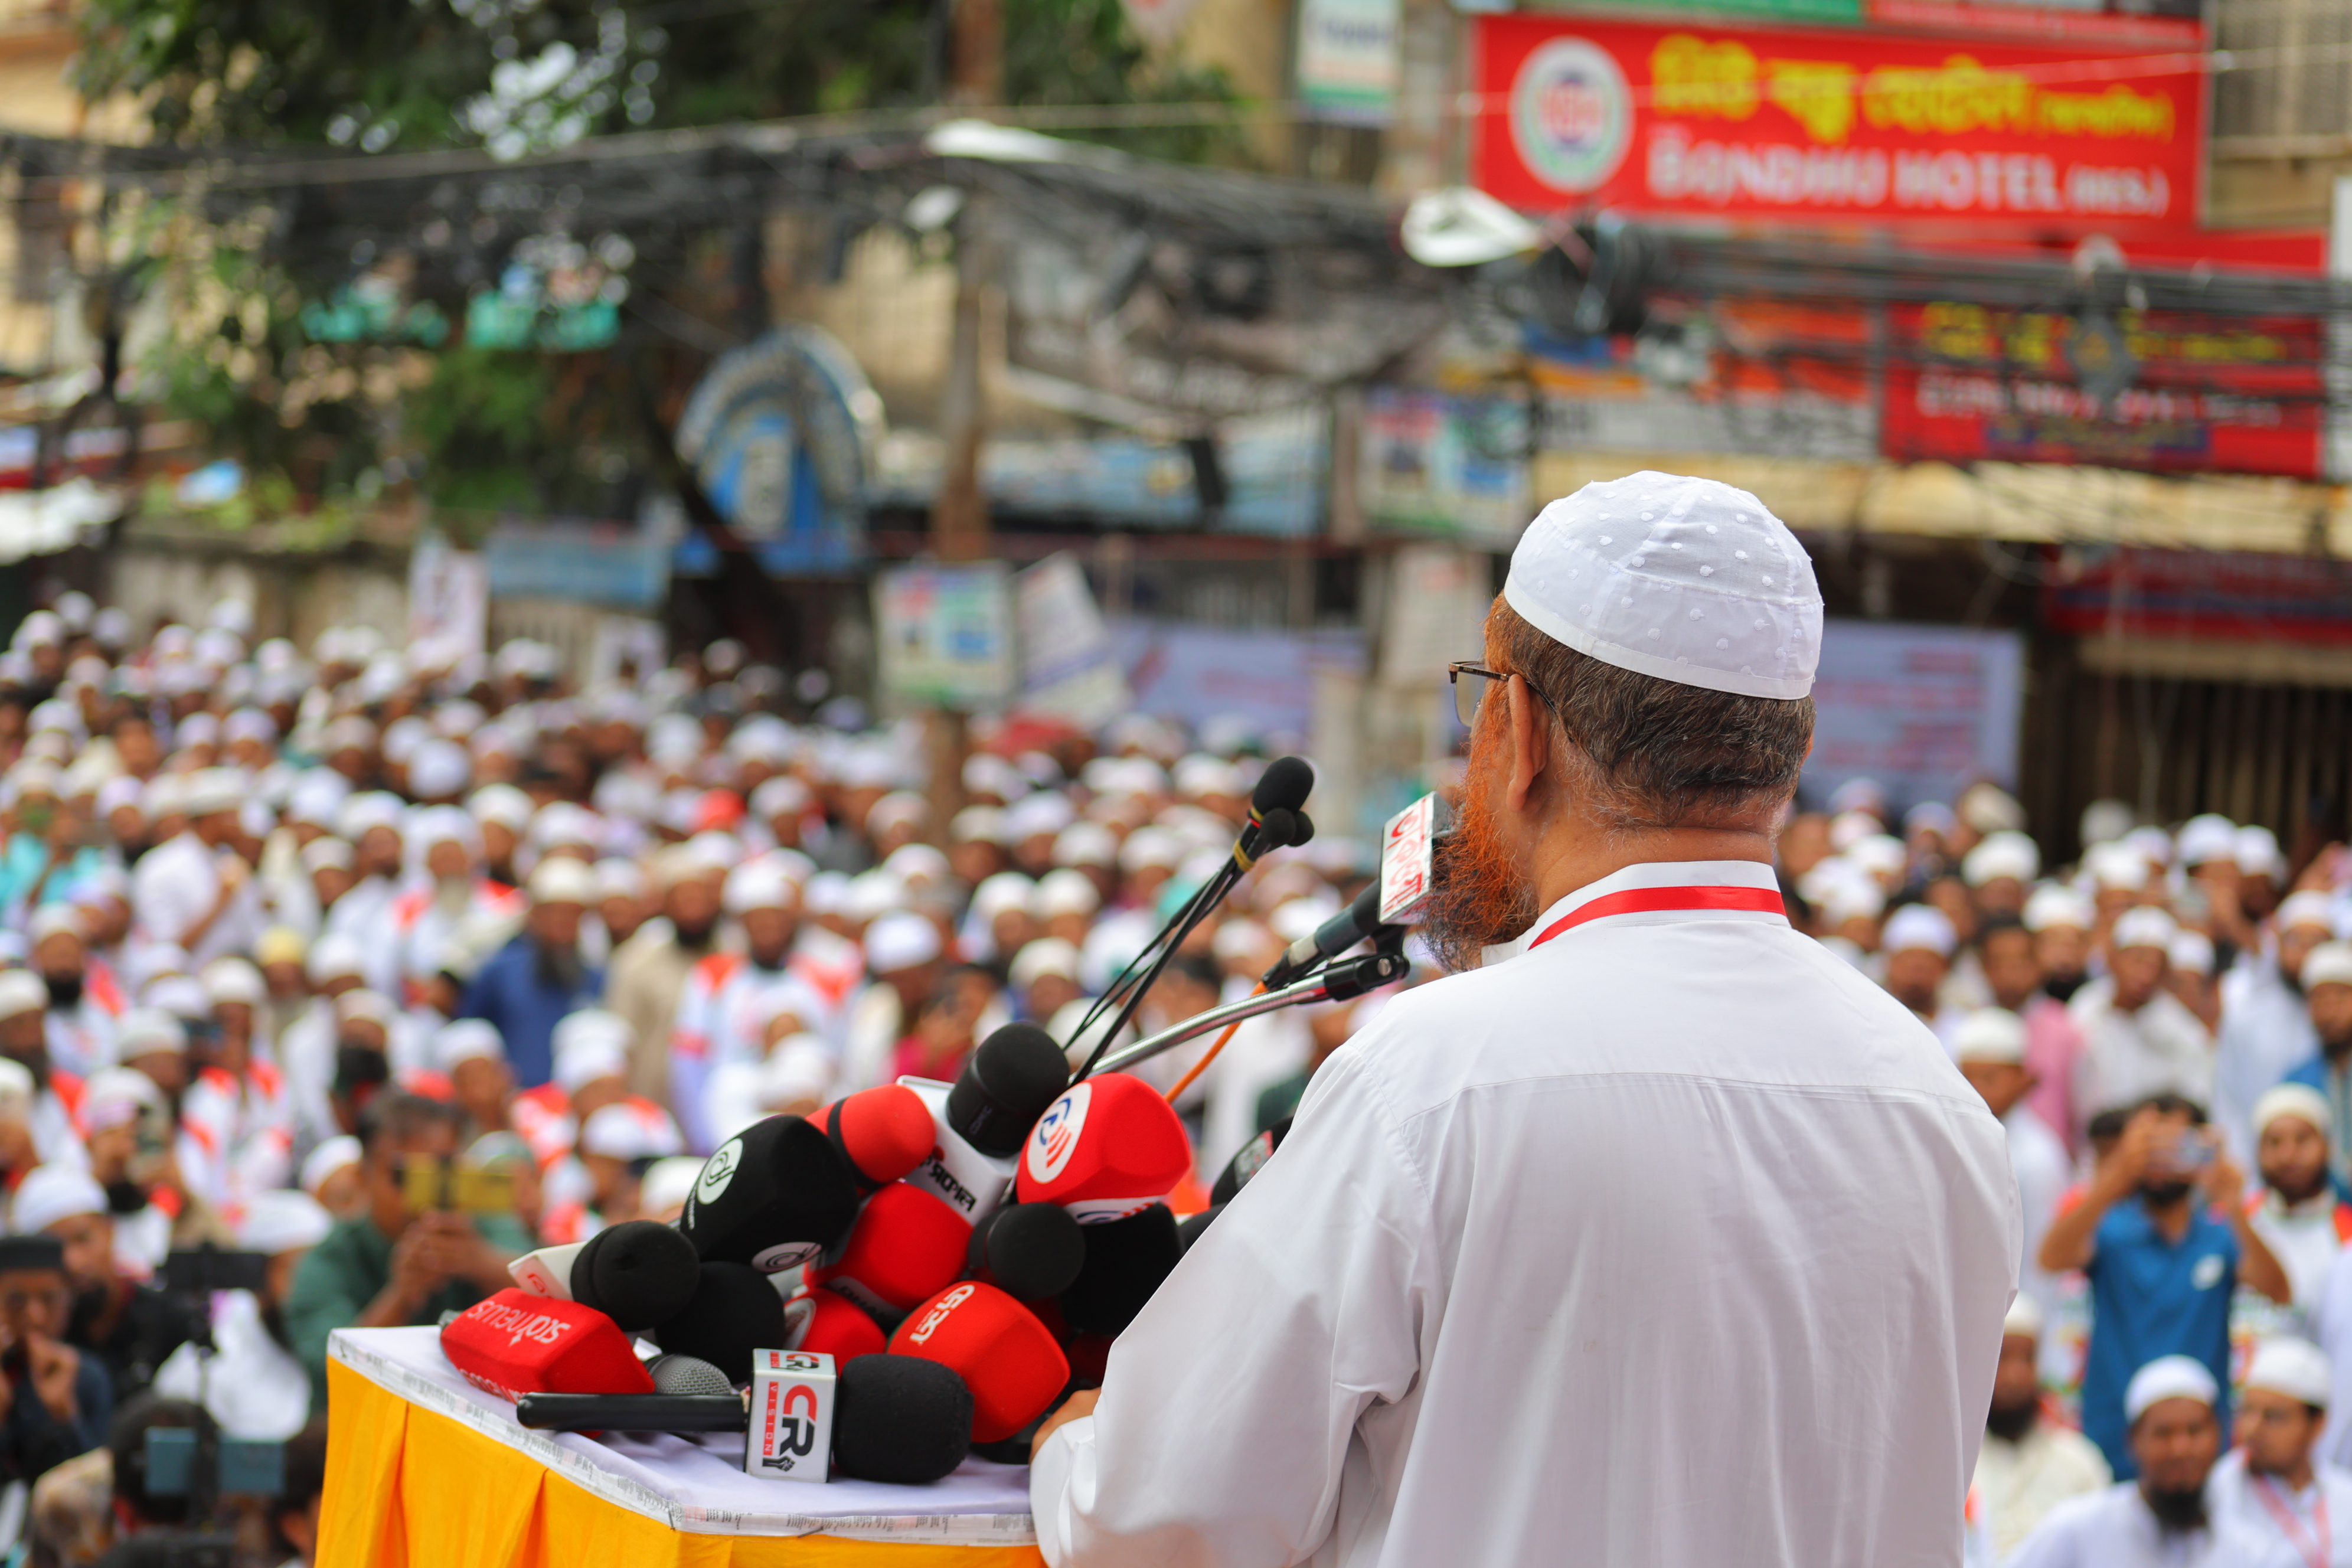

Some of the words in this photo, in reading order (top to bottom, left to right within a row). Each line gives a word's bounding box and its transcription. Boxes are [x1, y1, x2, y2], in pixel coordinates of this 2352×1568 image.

[1893, 146, 2063, 213] HOTEL
[764, 1384, 778, 1452] VISION
[779, 1384, 818, 1456] CR
